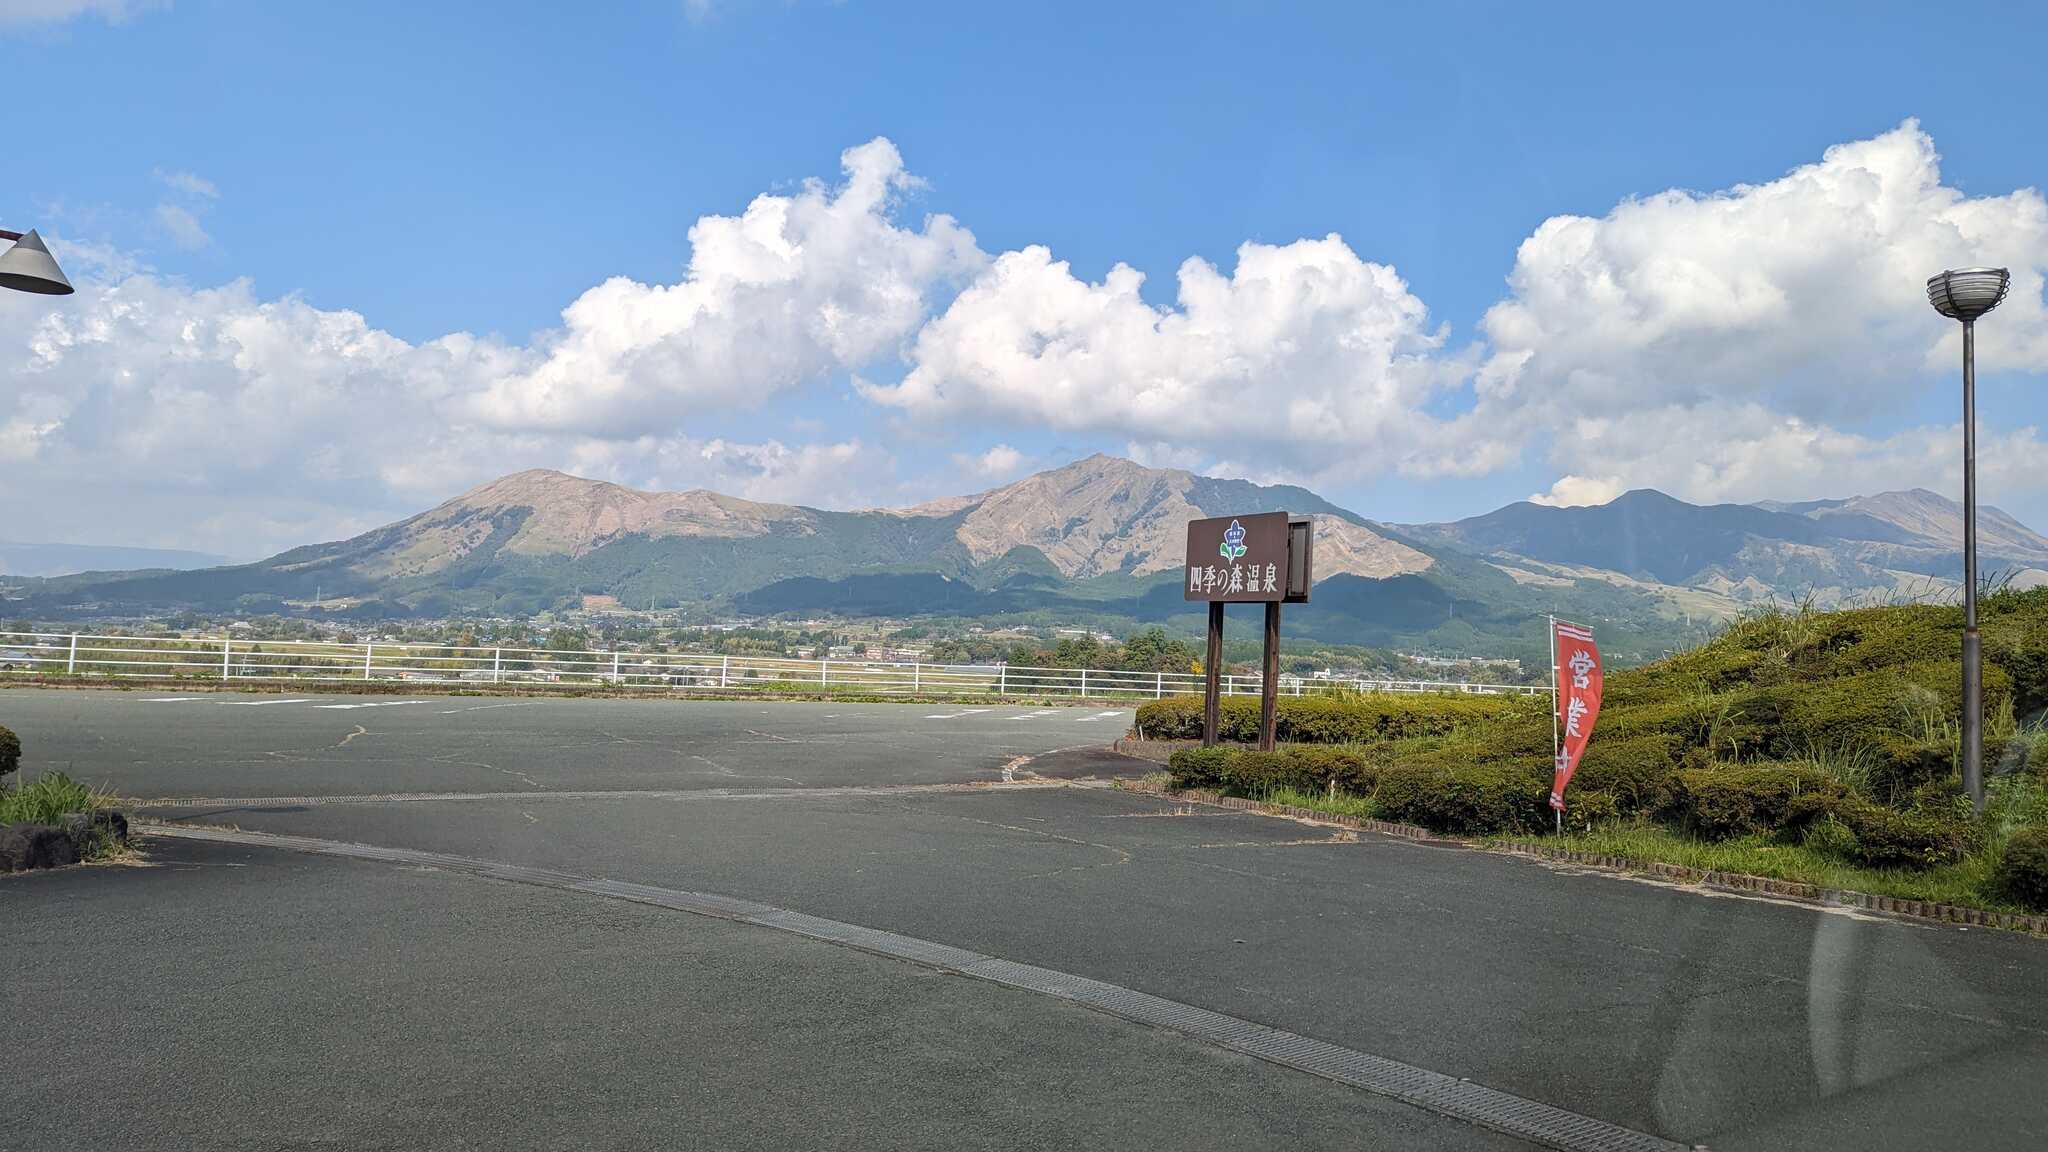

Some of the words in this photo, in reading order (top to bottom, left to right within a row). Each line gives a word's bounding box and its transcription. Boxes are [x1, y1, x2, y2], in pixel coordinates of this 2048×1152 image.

[1190, 563, 1278, 596] 四季の森温泉
